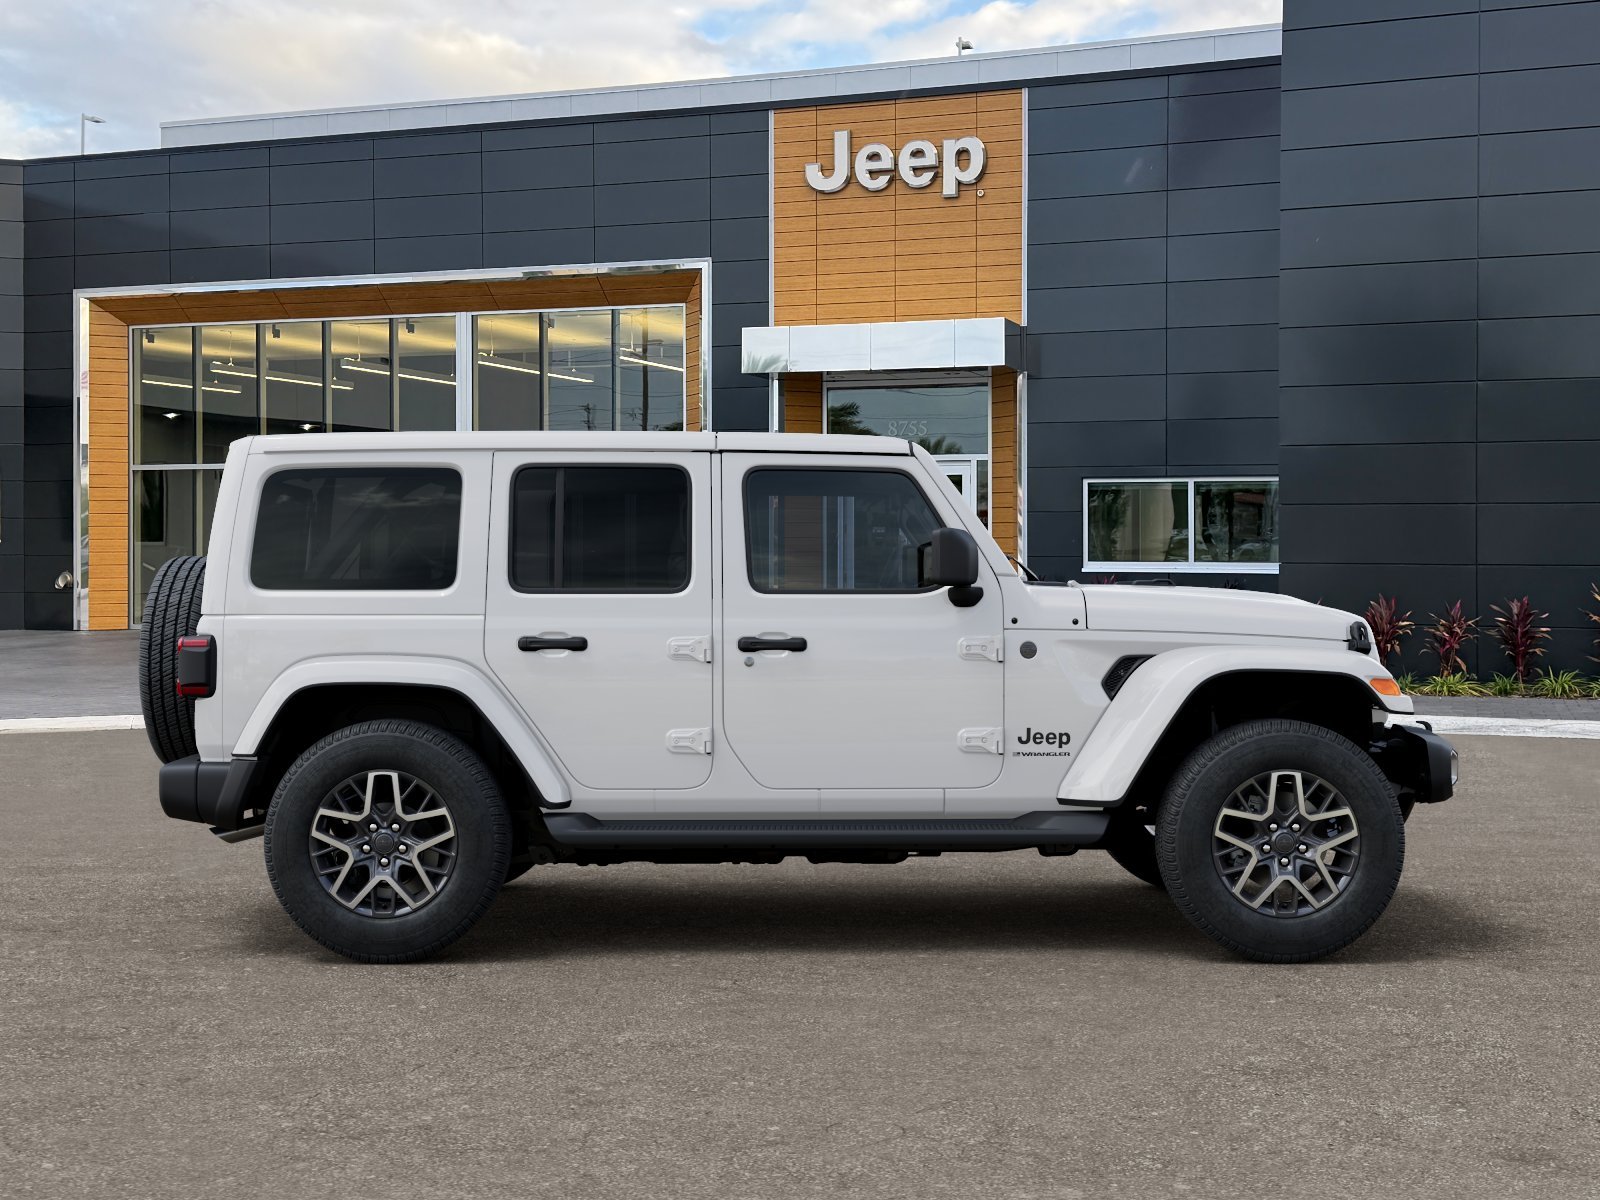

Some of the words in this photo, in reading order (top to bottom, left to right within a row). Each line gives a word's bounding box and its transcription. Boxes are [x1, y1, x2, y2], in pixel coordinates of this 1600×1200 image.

[805, 129, 987, 198] Jeep
[888, 420, 928, 437] 8755
[1017, 727, 1071, 748] Jeep
